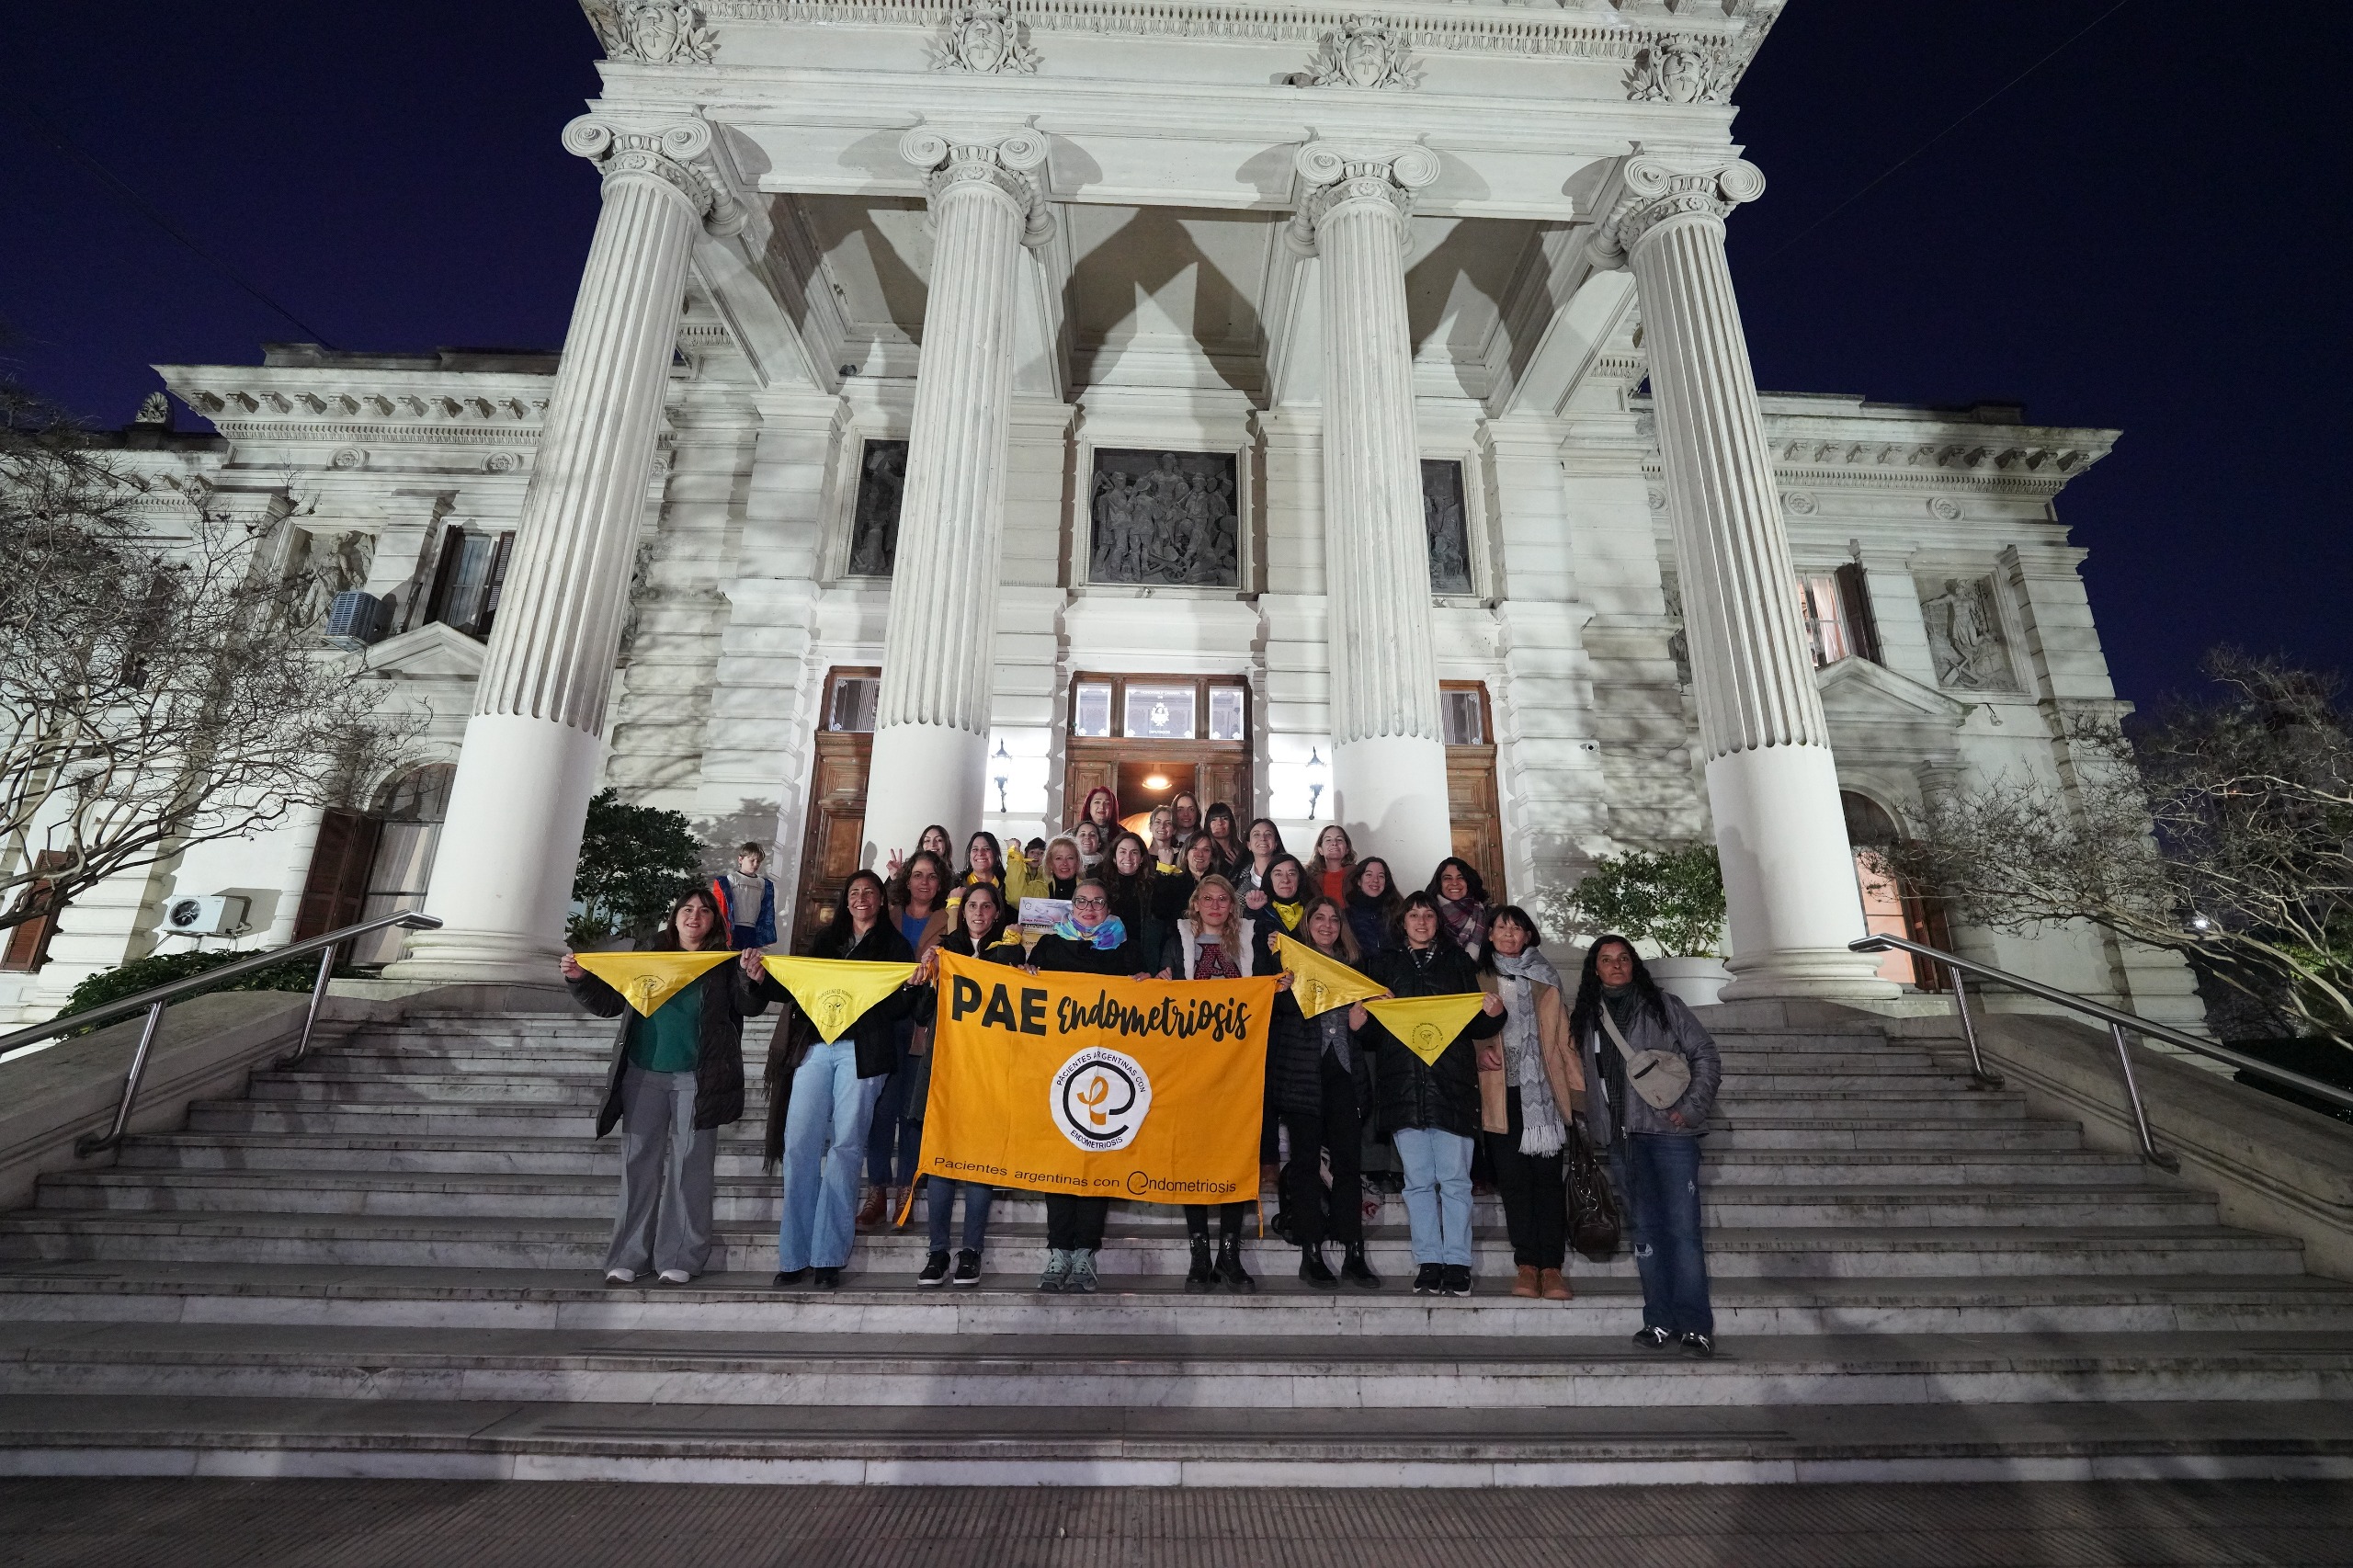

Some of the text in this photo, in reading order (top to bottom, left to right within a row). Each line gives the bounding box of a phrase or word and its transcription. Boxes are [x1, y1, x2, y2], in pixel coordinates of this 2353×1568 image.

[951, 974, 1252, 1042] PAE Endometriosis
[1056, 1051, 1146, 1093] PACIENTES ARGENTINAS CON
[1070, 1129, 1123, 1149] ENDOMETRIOSIS
[934, 1157, 1007, 1176] Pacientes
[1014, 1170, 1088, 1188] argentinas
[1093, 1177, 1120, 1187] con
